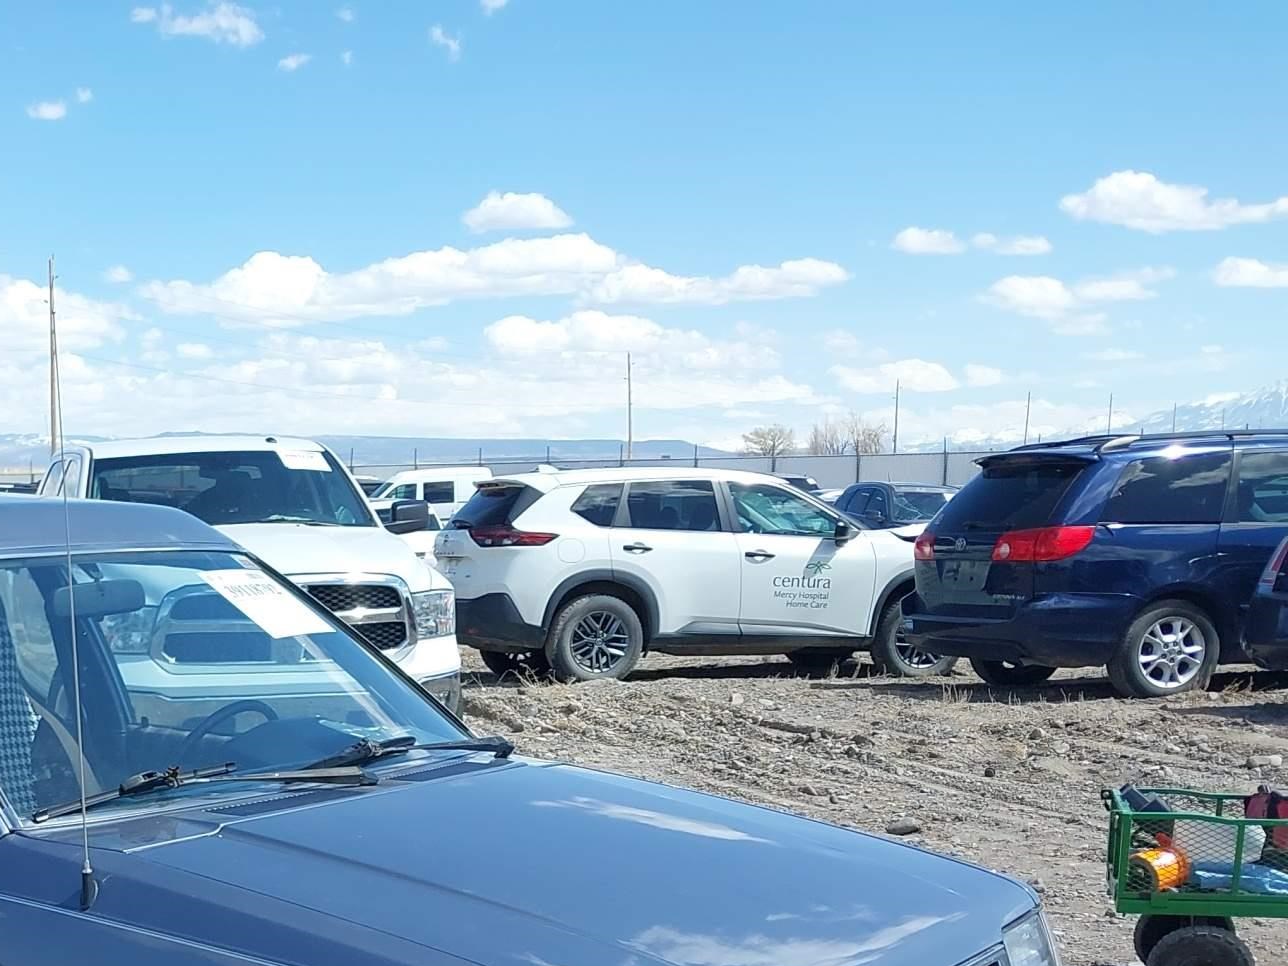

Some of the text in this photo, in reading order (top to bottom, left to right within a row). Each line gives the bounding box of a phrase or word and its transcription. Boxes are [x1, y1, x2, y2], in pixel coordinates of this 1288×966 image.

[773, 575, 831, 589] centura
[774, 590, 829, 601] Mercy Hospital
[785, 600, 828, 609] Home Care
